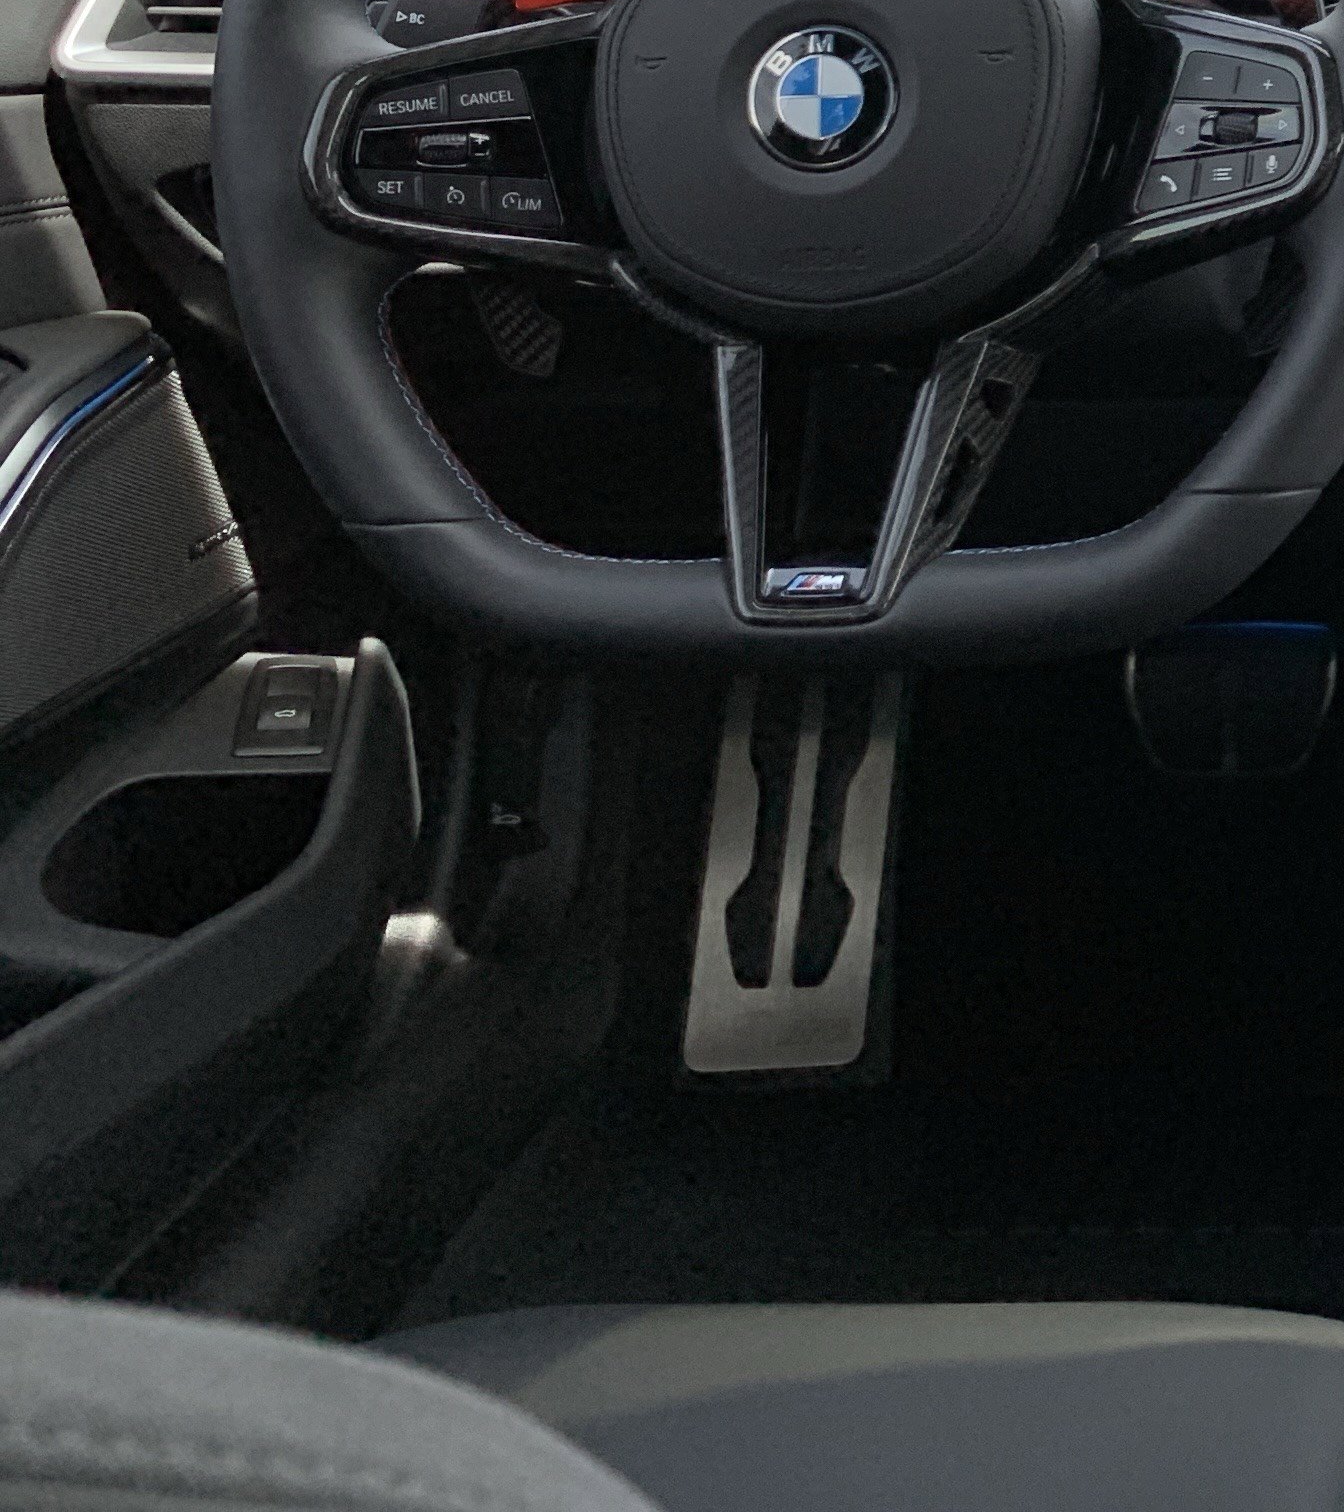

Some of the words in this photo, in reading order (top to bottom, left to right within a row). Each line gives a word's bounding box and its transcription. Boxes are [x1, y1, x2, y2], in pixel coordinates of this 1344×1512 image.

[409, 13, 425, 25] BC
[766, 33, 882, 77] BMW
[378, 95, 439, 116] RESUME
[459, 89, 515, 107] CANCEL
[377, 180, 404, 195] SET
[517, 197, 542, 211] LIM
